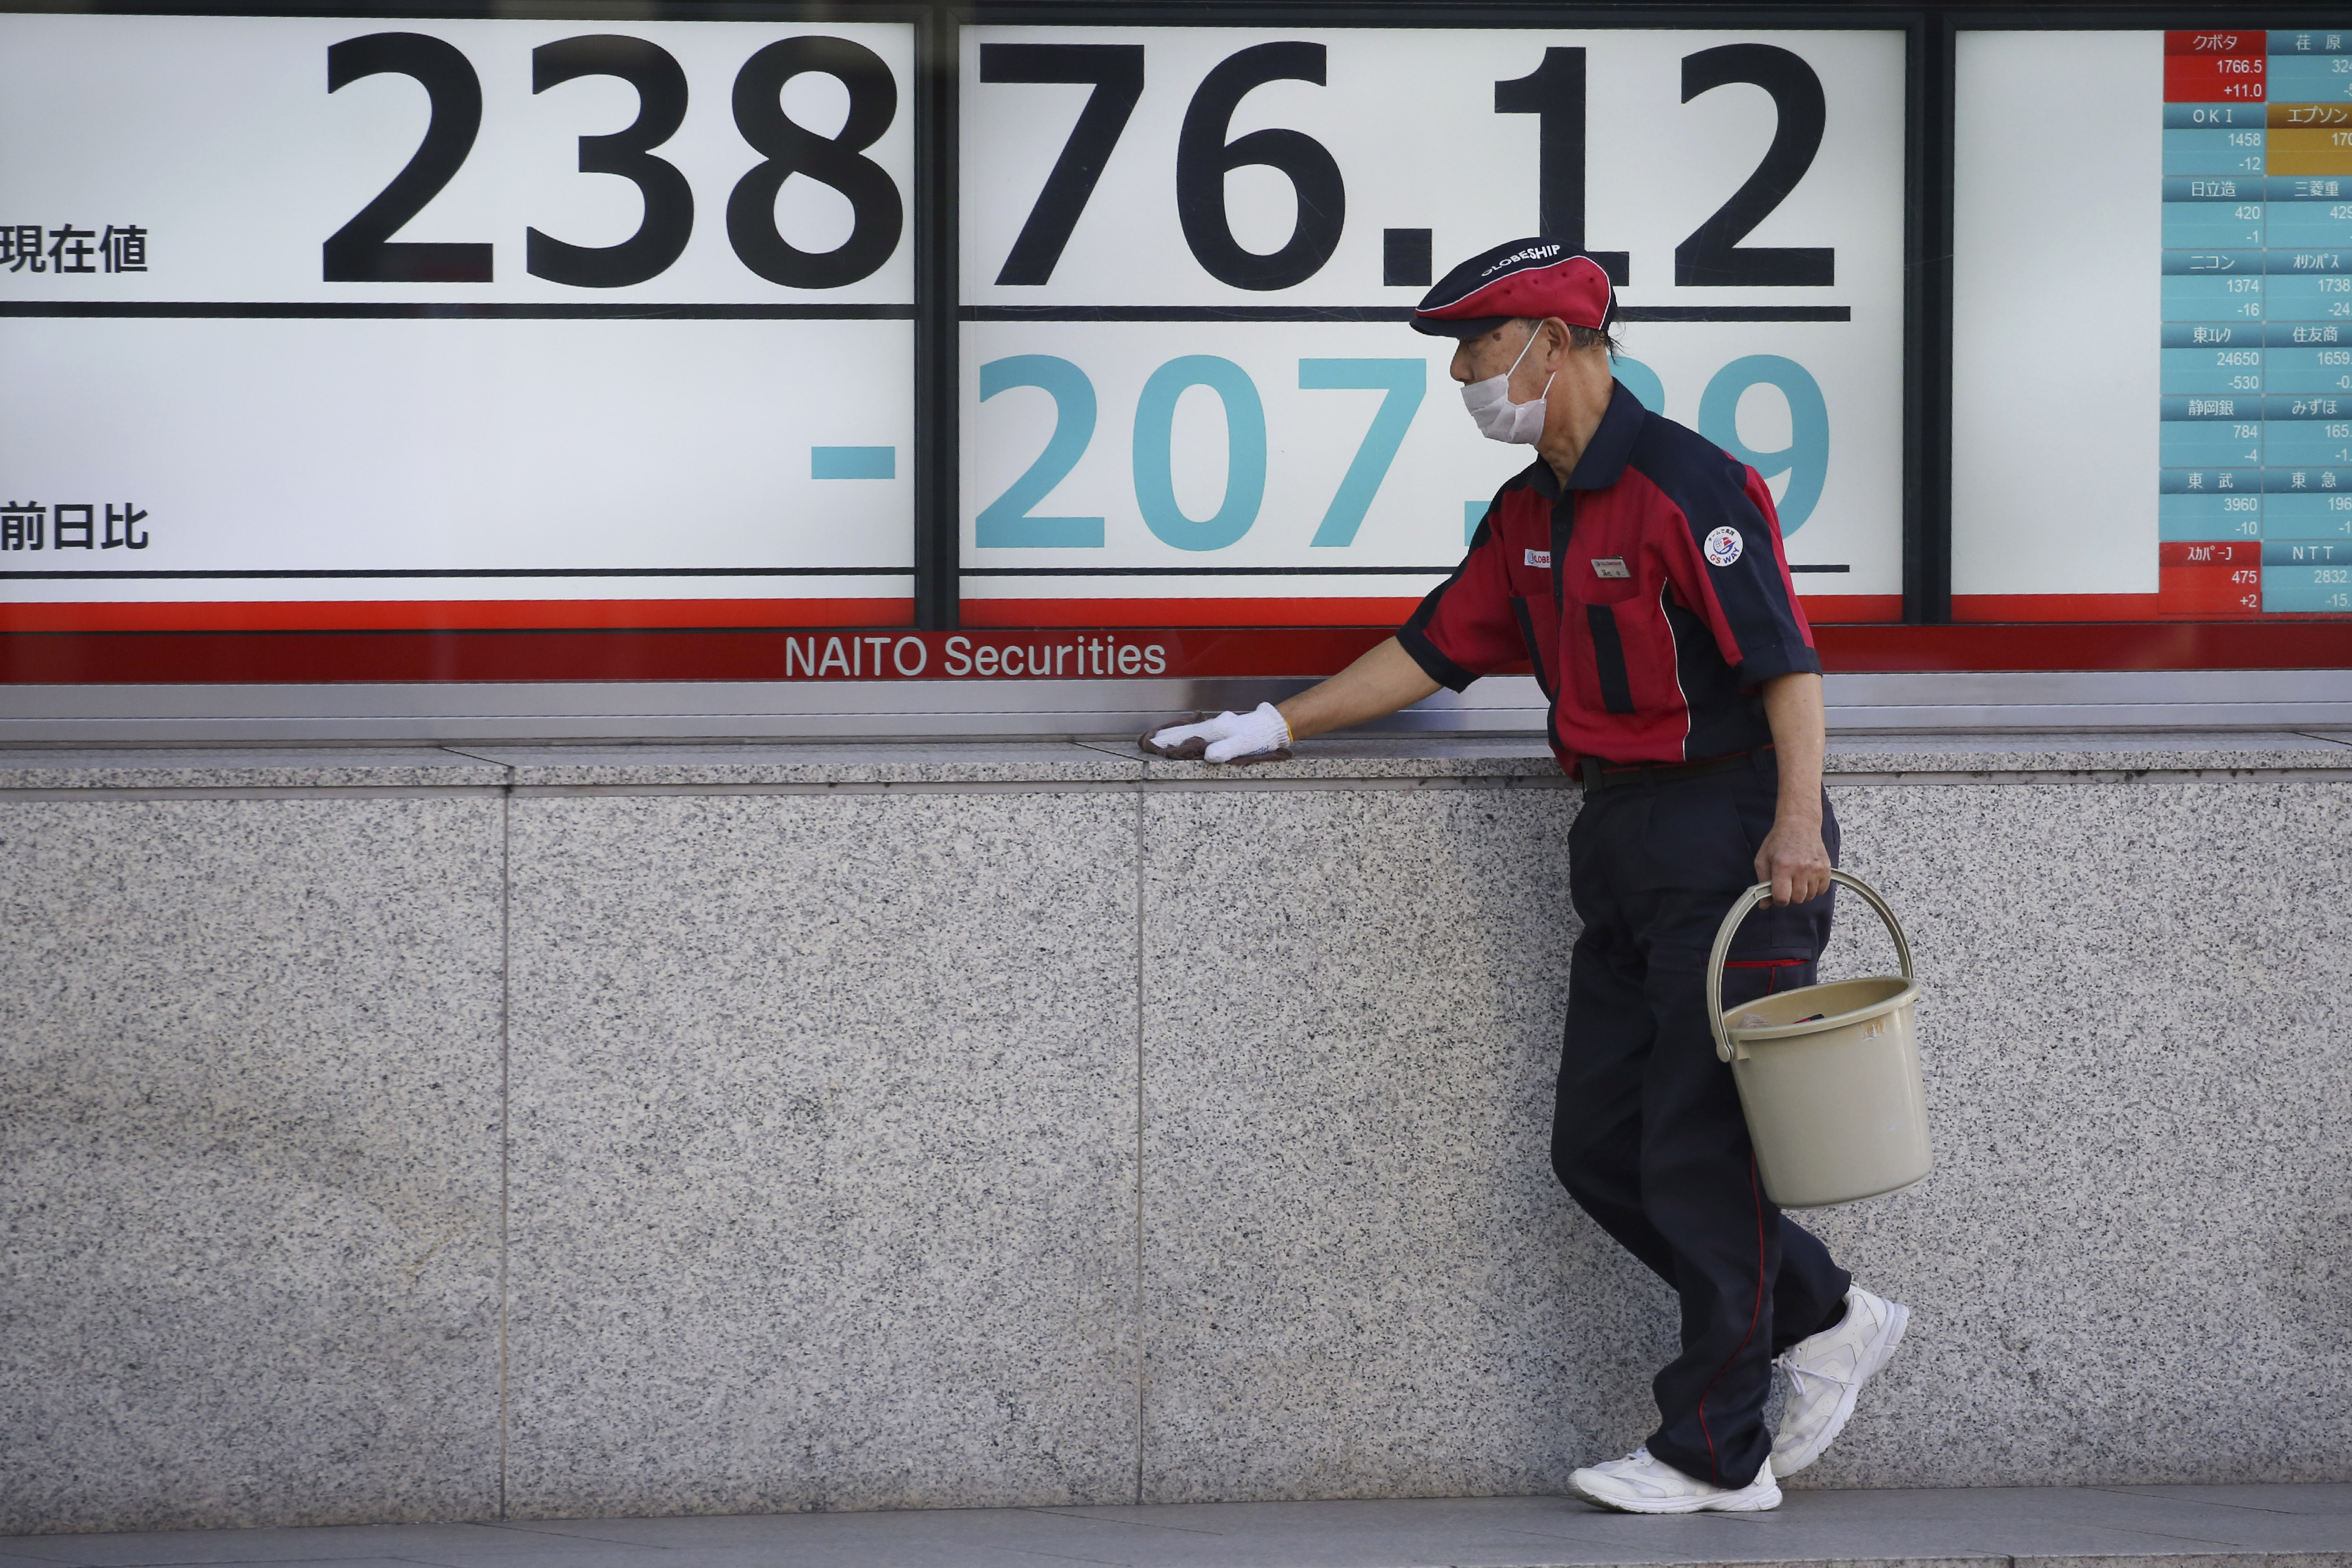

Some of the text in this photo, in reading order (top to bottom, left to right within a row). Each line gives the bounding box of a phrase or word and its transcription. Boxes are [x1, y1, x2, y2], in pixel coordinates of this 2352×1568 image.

[2193, 34, 2238, 50] クボタ
[2217, 60, 2262, 73] 1766.5
[2224, 84, 2262, 97] +11.0
[2193, 109, 2232, 122] OKI
[2287, 106, 2348, 122] エプソン
[2229, 133, 2261, 146] 1458
[2239, 157, 2261, 170] -12
[2192, 181, 2236, 197] 日立造
[2294, 181, 2339, 196] 三菱重
[2235, 206, 2261, 219] 420
[2247, 230, 2258, 243] -1
[0, 224, 148, 273] 現在値
[2190, 256, 2235, 270] ニコン
[2227, 279, 2259, 292] 1374
[2238, 303, 2259, 316] -16
[2293, 326, 2338, 342] 住友商
[2217, 352, 2259, 365] 24650
[2228, 376, 2258, 389] -530
[2188, 399, 2234, 416] 静岡銀
[2292, 399, 2337, 414] みずほ
[2234, 425, 2258, 438] 784
[2245, 449, 2257, 461] -4
[2224, 498, 2257, 511] 3960
[0, 500, 148, 550] 前日比
[2235, 521, 2257, 535] -10
[1710, 547, 1740, 564] GS WAY
[2292, 546, 2334, 559] NTT
[2232, 570, 2257, 584] 475
[2240, 595, 2257, 608] +2
[786, 635, 1166, 677] NAITO Securities
